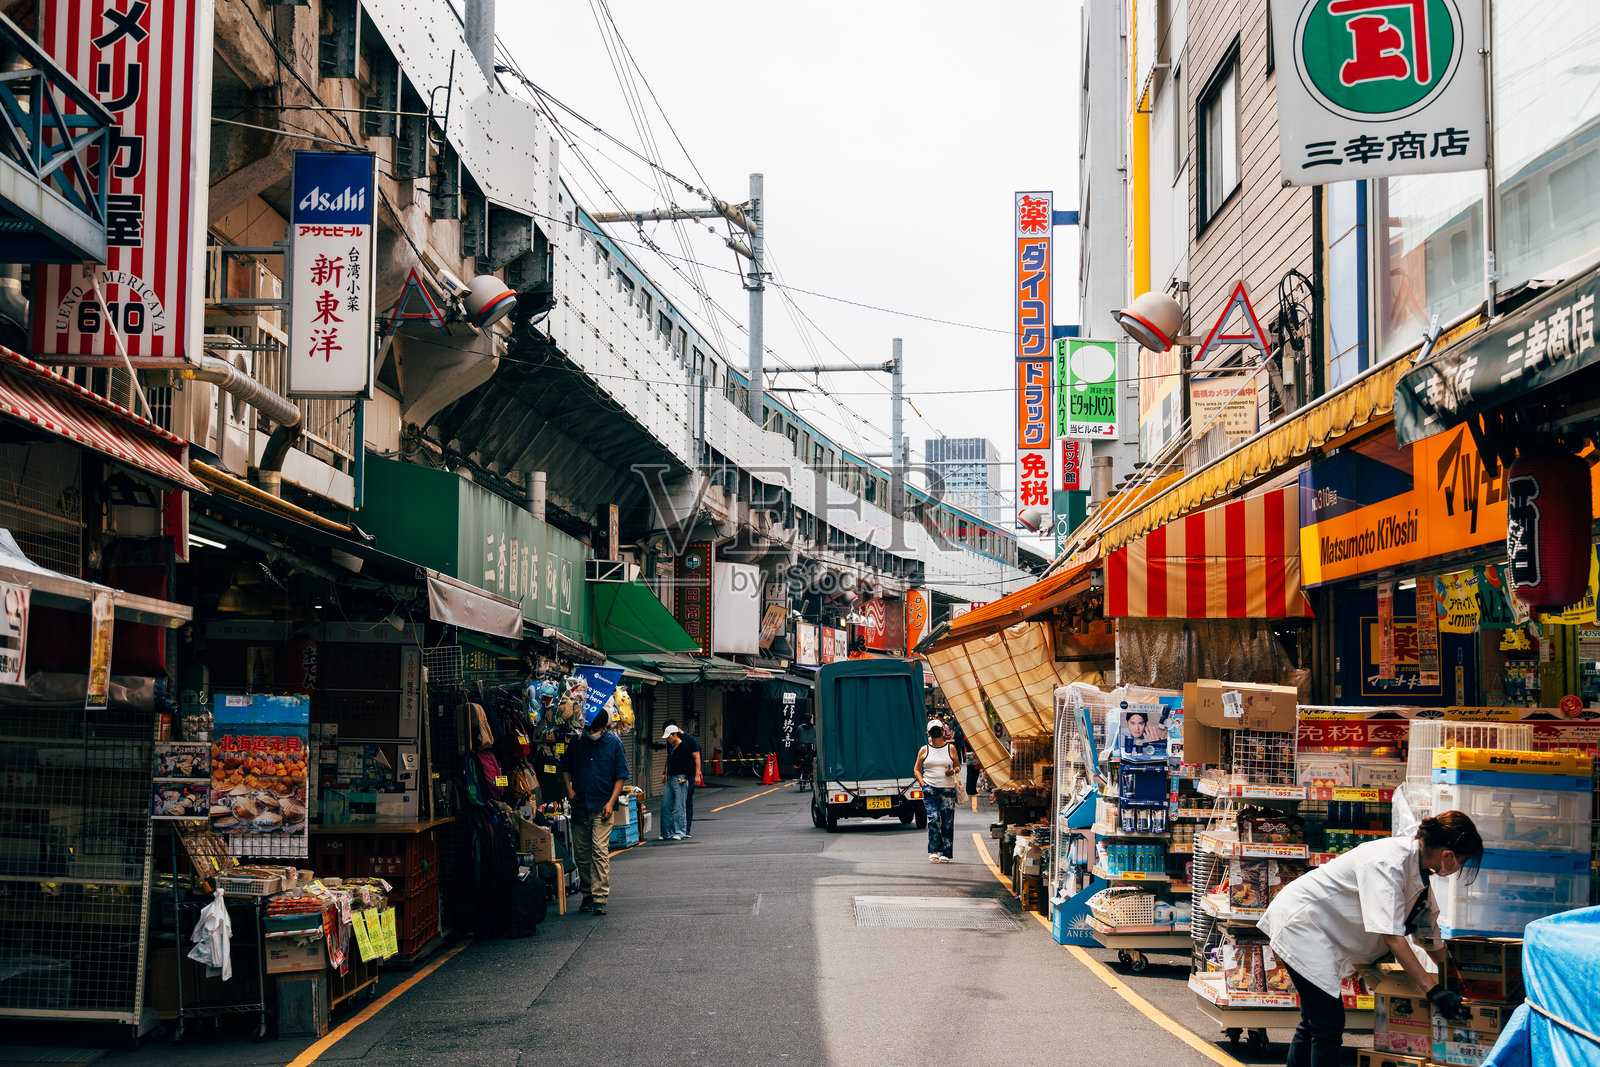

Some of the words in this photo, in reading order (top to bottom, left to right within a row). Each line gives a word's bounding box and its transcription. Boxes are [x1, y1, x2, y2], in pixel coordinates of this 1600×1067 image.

[1301, 128, 1470, 169] 三幸商店
[299, 185, 366, 212] Asahi
[1020, 196, 1049, 234] 薬
[299, 226, 363, 237] アサヒビール
[346, 246, 361, 312] 台湾小菜
[1021, 242, 1047, 356] ダイコク
[56, 286, 83, 330] UENO
[98, 271, 165, 332] MERICAYA
[77, 301, 145, 335] 610
[308, 253, 346, 363] 新東洋
[1500, 294, 1595, 384] 三幸商店
[1024, 364, 1044, 446] ドラッグ
[1058, 341, 1066, 436] ピタットハウス
[1070, 394, 1115, 417] ピタットハウス
[1020, 452, 1049, 507] 免税
[1320, 528, 1375, 567] Matsumoto
[1377, 508, 1418, 551] KiYoshi
[914, 597, 923, 628] ロンドン
[219, 735, 300, 751] 北海道元貝
[1297, 724, 1364, 742] 免税
[1066, 929, 1093, 938] ANESS
